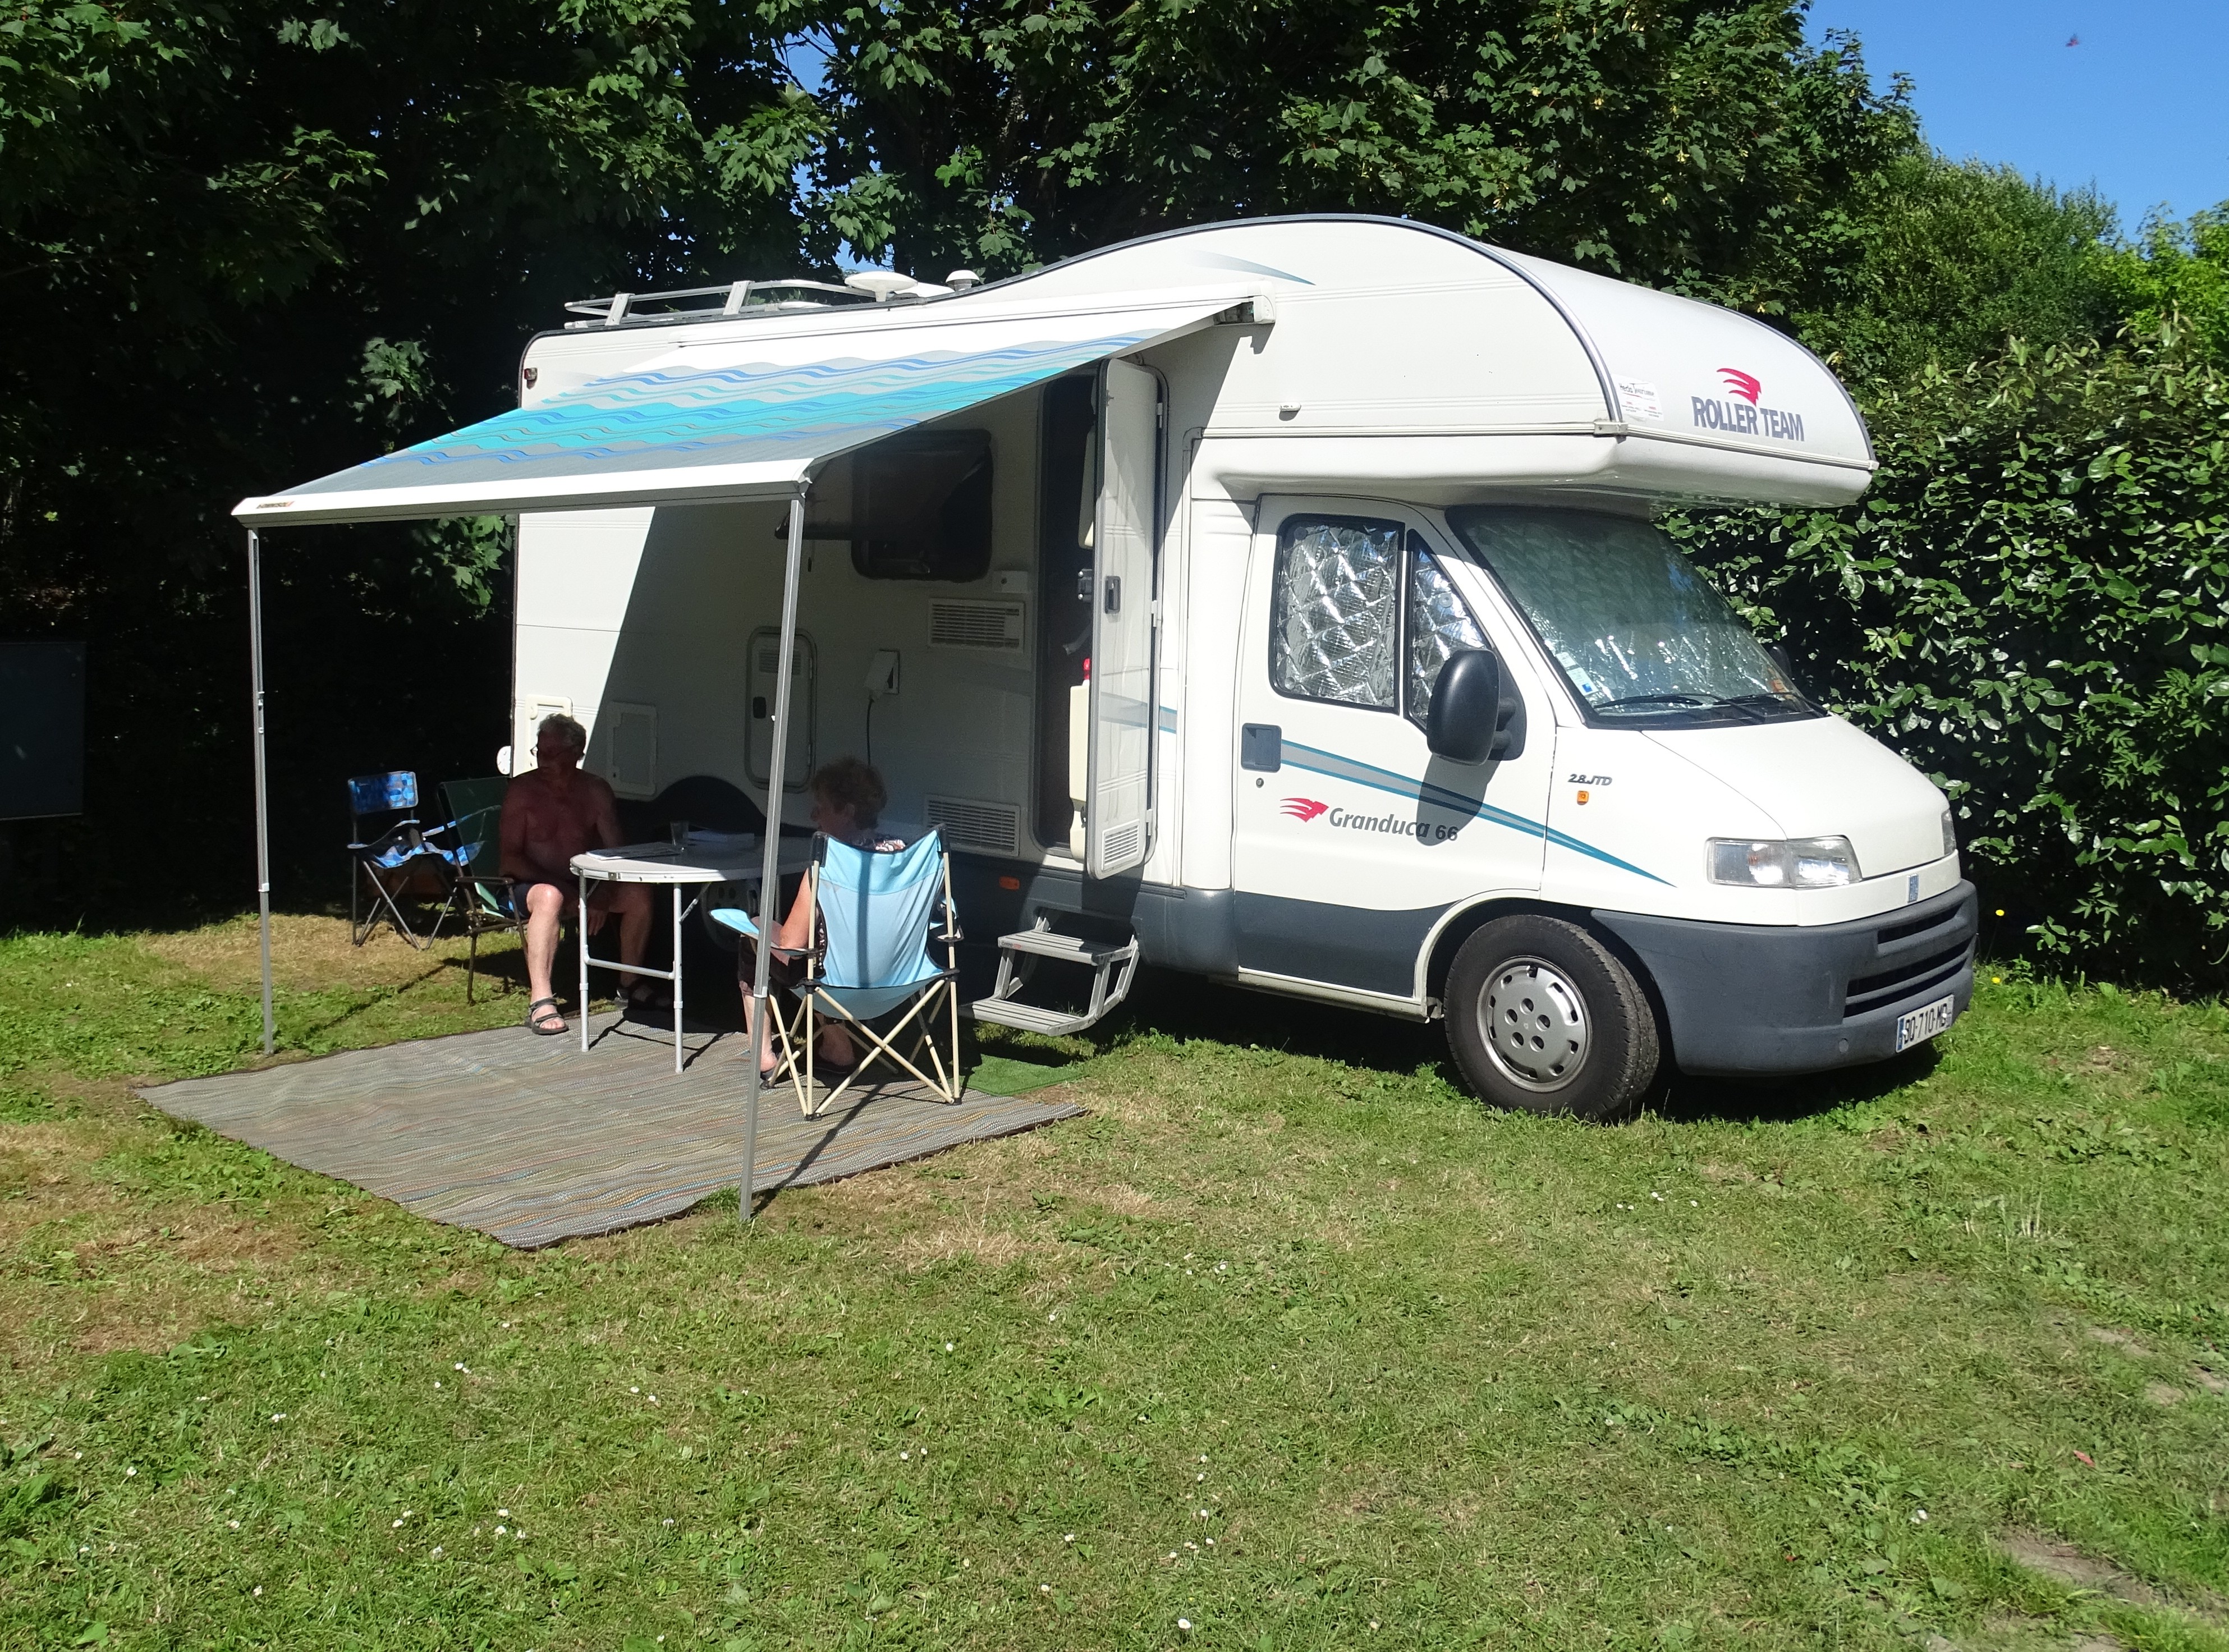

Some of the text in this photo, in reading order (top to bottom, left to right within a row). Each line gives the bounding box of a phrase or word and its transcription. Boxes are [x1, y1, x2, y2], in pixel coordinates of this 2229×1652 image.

[1691, 396, 1805, 442] ROLLER TEAM
[1329, 807, 1459, 841] Granduca 66
